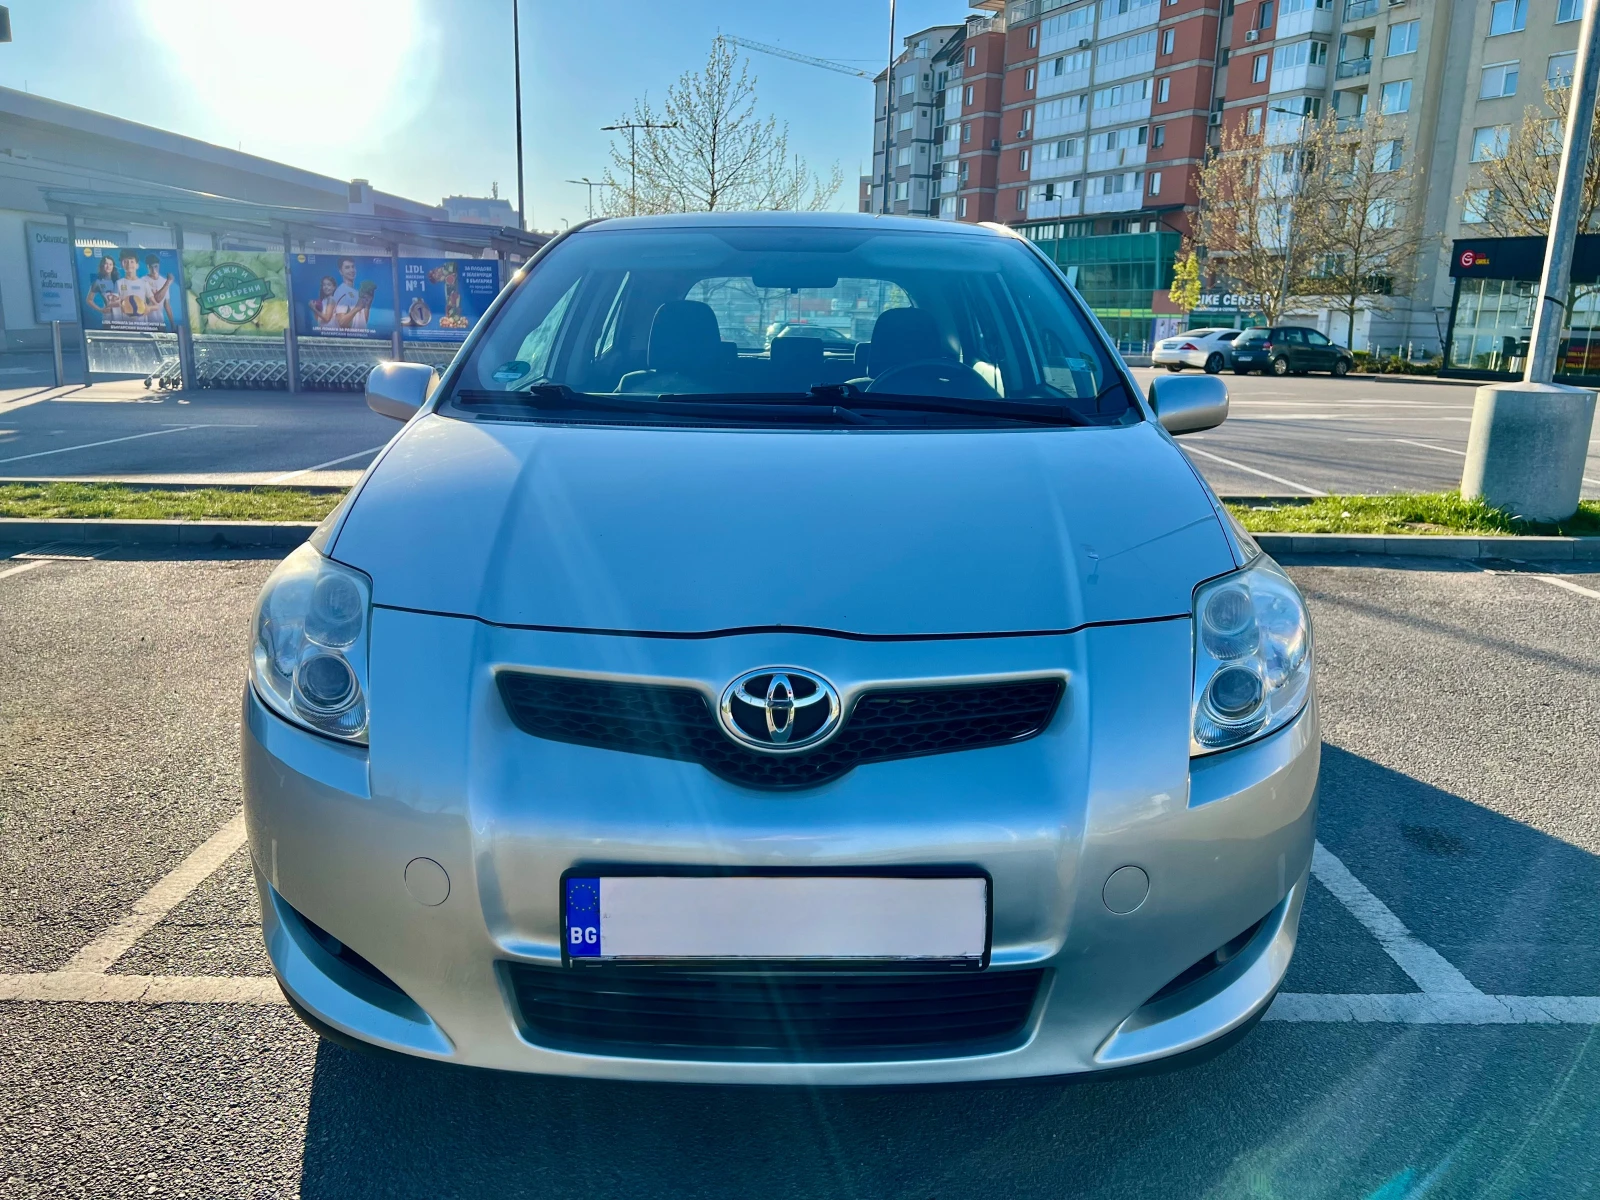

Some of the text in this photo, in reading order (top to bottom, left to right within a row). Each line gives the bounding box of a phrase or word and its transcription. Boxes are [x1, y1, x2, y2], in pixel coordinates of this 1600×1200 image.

[209, 267, 248, 286] СВЕЖИ И
[405, 265, 424, 274] LIDL
[207, 284, 261, 303] ПРОВЕРЕНИ
[420, 281, 426, 291] 1
[570, 926, 597, 944] BG
